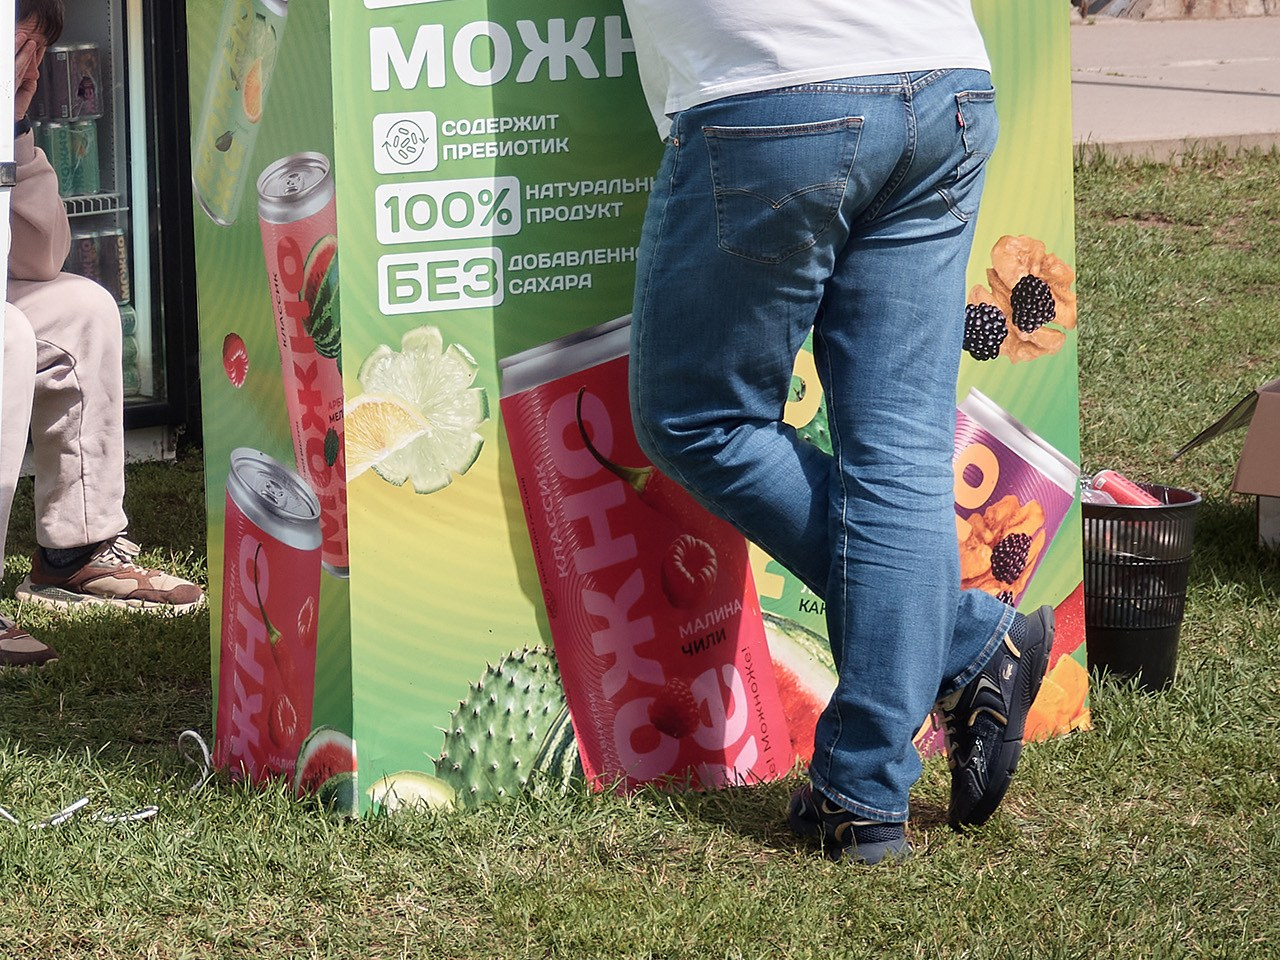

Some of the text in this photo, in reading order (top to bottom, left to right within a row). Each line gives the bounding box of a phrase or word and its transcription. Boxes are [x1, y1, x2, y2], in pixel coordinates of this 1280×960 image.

[369, 15, 638, 92] МОЖН
[442, 114, 559, 137] СОДЕРЖИТ
[443, 137, 569, 160] ПРЕБИОТИК
[526, 177, 656, 200] НАТУРАЛЬН
[384, 187, 513, 234] 100%
[526, 202, 623, 225] ПРОДУКТ
[508, 247, 639, 271] ДОБАВЛЕНН
[386, 256, 498, 307] БЕЗ
[509, 274, 592, 295] САХАРА
[272, 272, 288, 348] КЛАССИК
[535, 463, 568, 579] КЛАССИК
[545, 387, 679, 782] ожно
[678, 599, 743, 638] МАЛИНА
[681, 628, 727, 657] ЧИЛИ
[268, 753, 296, 771] МАЛИН
